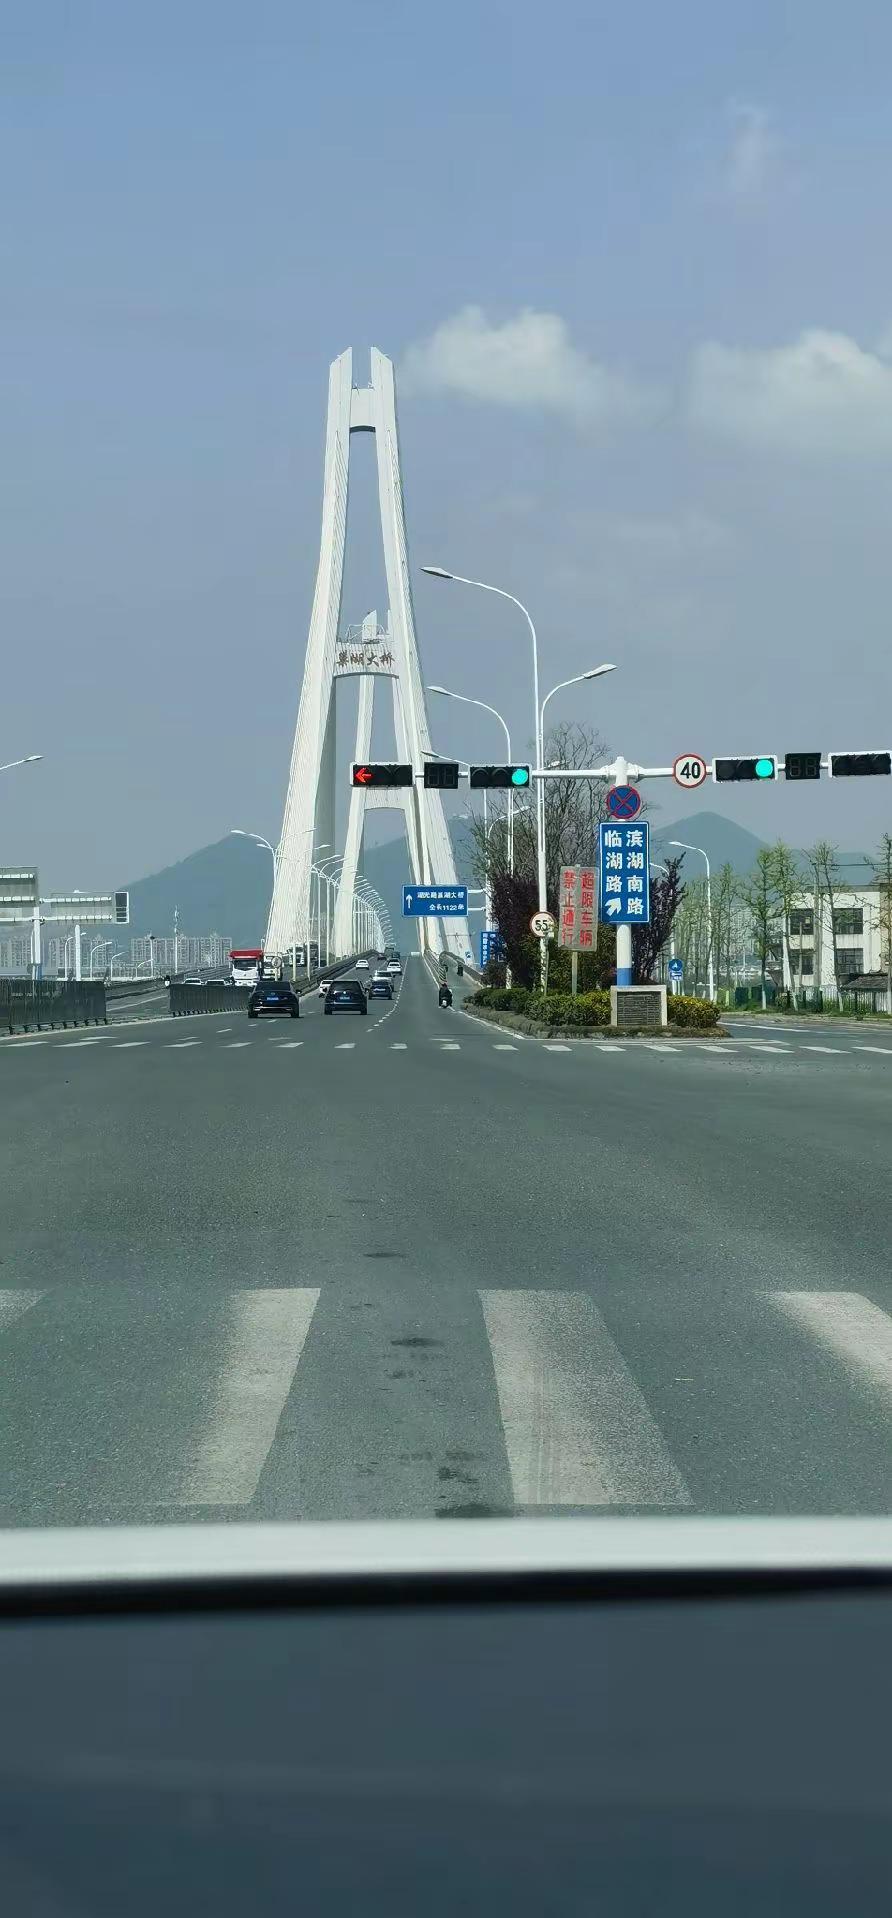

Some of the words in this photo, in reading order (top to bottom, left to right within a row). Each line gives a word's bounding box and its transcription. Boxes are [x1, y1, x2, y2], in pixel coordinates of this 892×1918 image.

[680, 761, 701, 779] 40
[604, 830, 623, 893] 临湖路
[626, 830, 645, 915] 滨湖南路
[535, 919, 549, 931] 55
[562, 869, 575, 945] 禁止通行
[580, 871, 595, 947] 超限车辆
